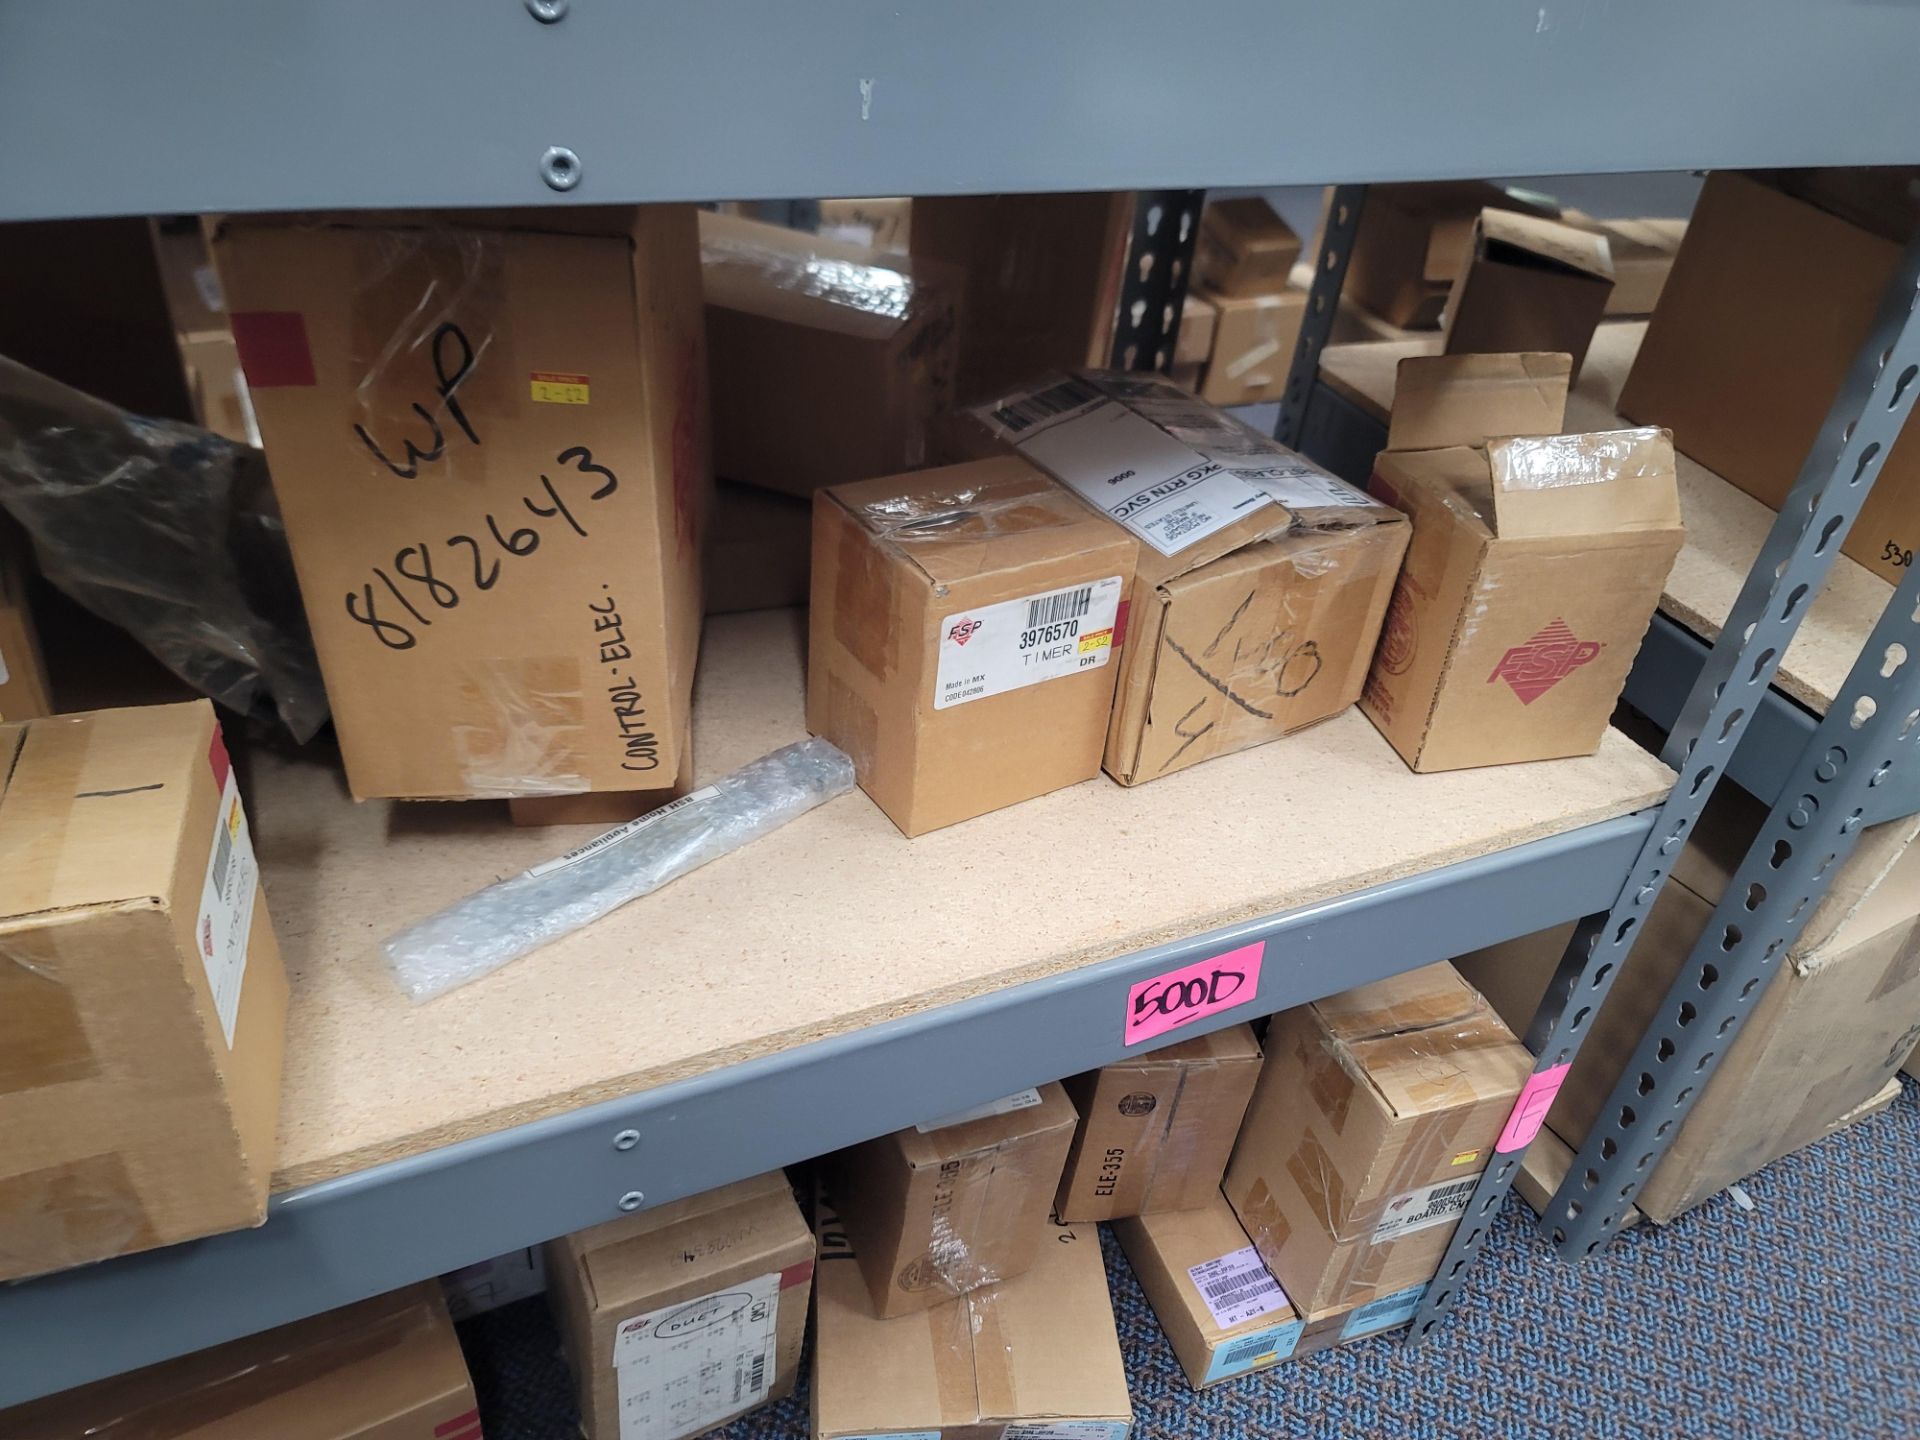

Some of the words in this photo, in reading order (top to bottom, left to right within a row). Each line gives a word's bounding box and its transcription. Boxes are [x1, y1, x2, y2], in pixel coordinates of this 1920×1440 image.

[354, 321, 480, 479] WP
[1150, 479, 1186, 500] RTN
[1115, 496, 1152, 517] SVC
[346, 446, 618, 650] 8182643
[1881, 540, 1912, 567] 530
[948, 619, 982, 641] FSP
[1019, 619, 1079, 650] 3976570
[1022, 643, 1073, 666] TIMER
[1079, 655, 1096, 667] DR
[1486, 641, 1602, 684] FSP
[945, 680, 962, 691] Made
[972, 673, 985, 684] MX
[669, 796, 694, 811] BSH
[632, 808, 668, 827] Home
[563, 826, 629, 860] Appliances
[1133, 970, 1246, 1027] 500D
[1094, 1148, 1125, 1197] ELE-355
[1406, 1200, 1471, 1224] BOARD,CN
[670, 1306, 720, 1331] DUET
